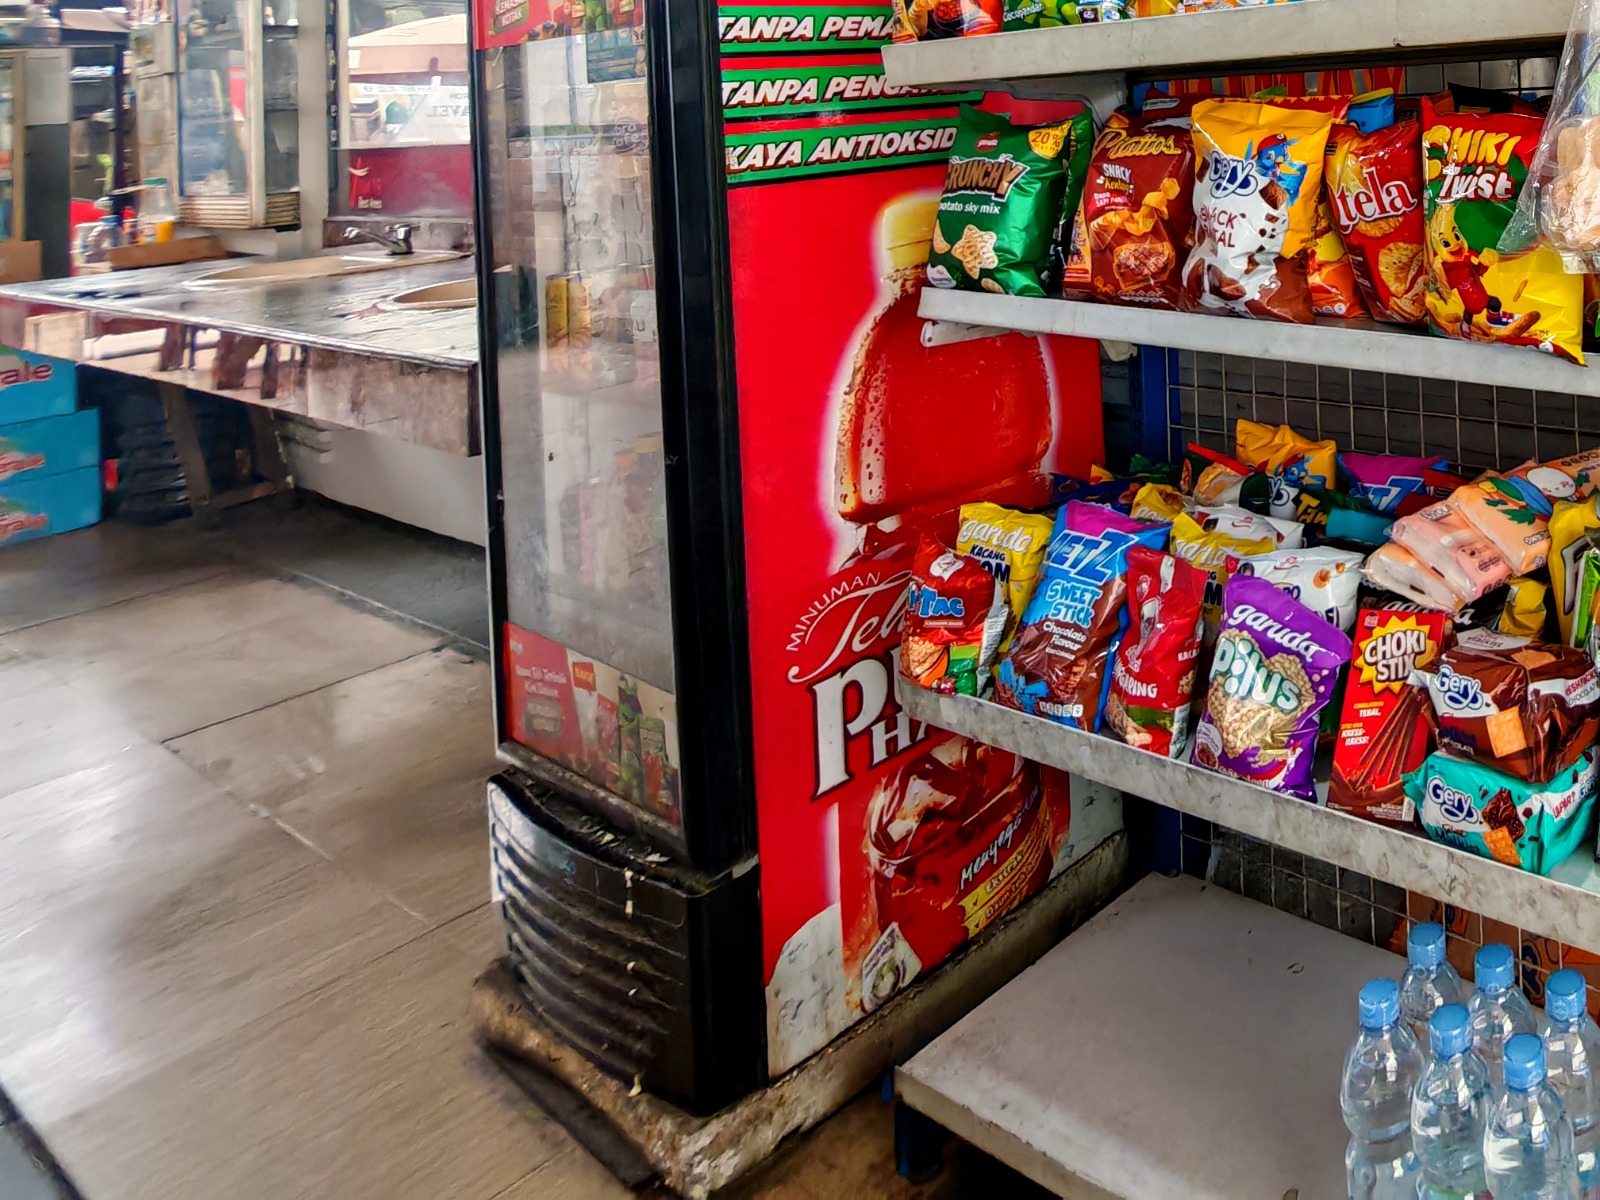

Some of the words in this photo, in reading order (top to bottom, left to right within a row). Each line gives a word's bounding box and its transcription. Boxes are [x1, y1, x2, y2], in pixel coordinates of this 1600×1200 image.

[718, 15, 815, 43] TANPA
[721, 77, 821, 107] TANPA
[726, 140, 803, 171] KAYA
[808, 126, 958, 165] ANTIOKSID
[1098, 127, 1183, 159] Piattos
[1102, 163, 1133, 184] SNACK
[1208, 150, 1259, 199] Gery
[1436, 165, 1513, 203] Twist
[964, 202, 979, 215] sky
[979, 202, 1001, 215] mix
[970, 543, 1007, 563] KACANG
[1046, 580, 1102, 607] SWEET
[787, 570, 881, 652] MINUMAN
[1042, 620, 1088, 644] Chocolate
[1051, 634, 1084, 651] Flavour
[1230, 603, 1327, 664] garuda
[1364, 629, 1427, 666] CHOKI
[1376, 653, 1417, 683] STIX
[1433, 665, 1484, 710] Gery
[1427, 776, 1480, 825] Gery
